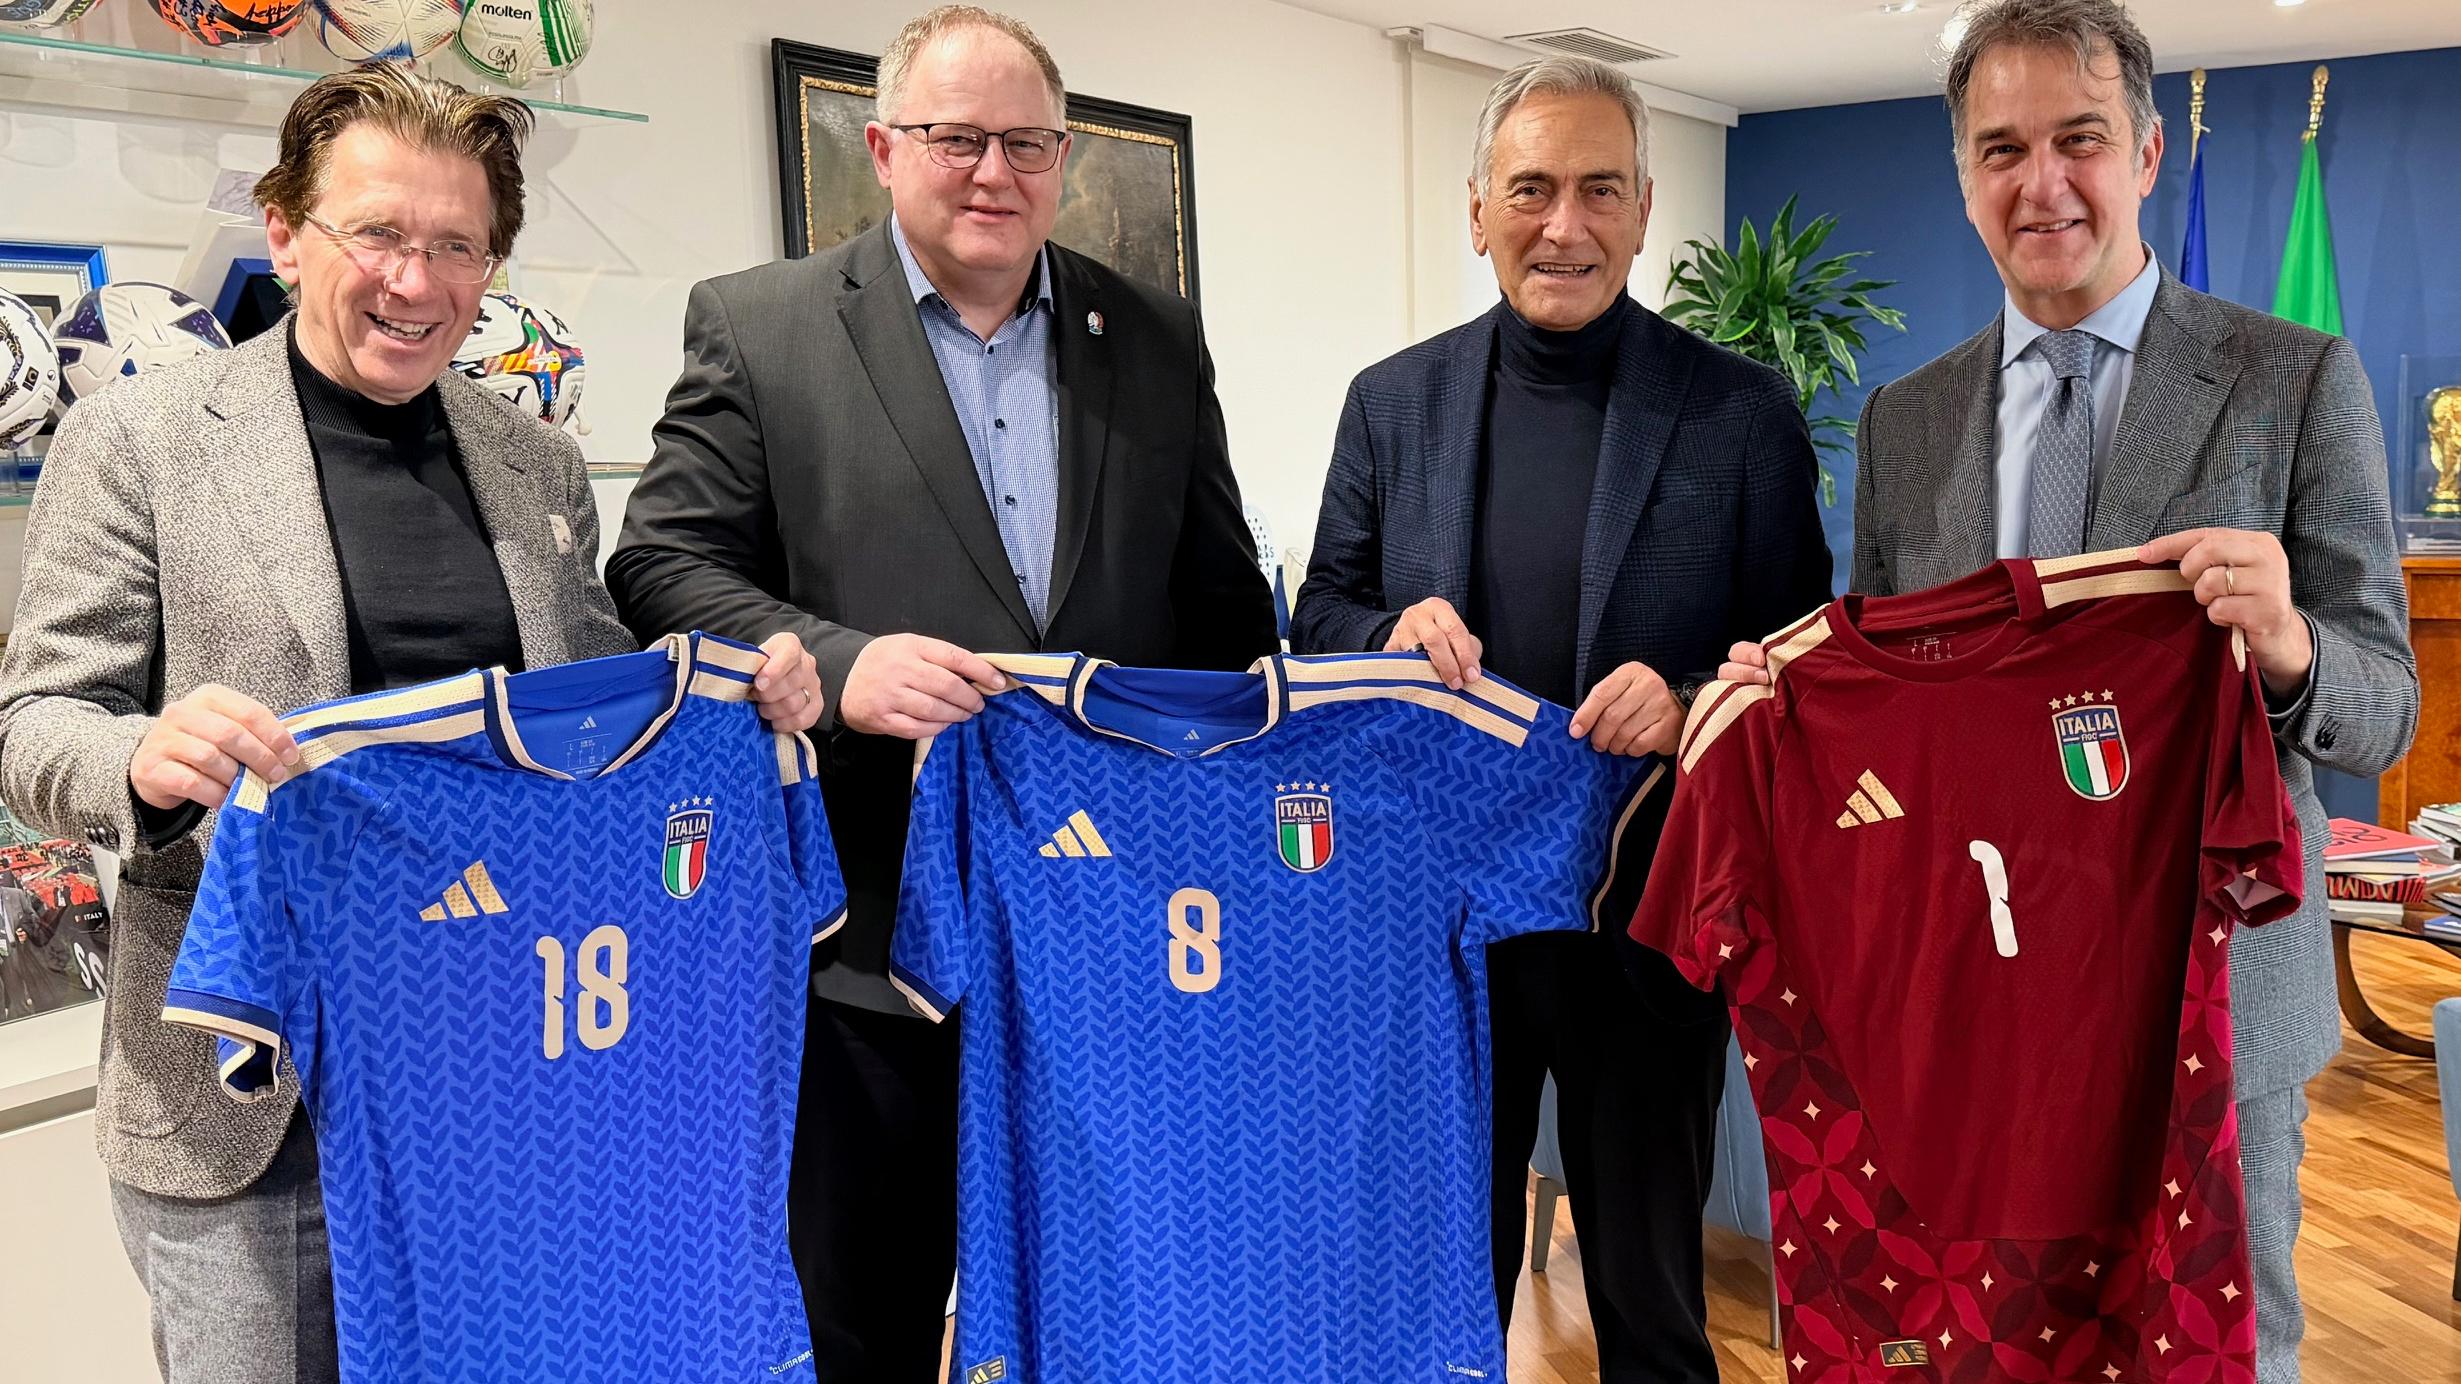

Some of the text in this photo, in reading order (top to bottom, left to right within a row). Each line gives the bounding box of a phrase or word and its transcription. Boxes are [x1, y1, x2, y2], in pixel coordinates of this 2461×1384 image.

[481, 4, 532, 21] molten
[2059, 712, 2115, 736] ITALIA
[1280, 801, 1327, 817] ITALIA
[670, 816, 708, 839] ITALIA
[1969, 840, 2018, 957] 1
[84, 911, 104, 922] ITALY
[1168, 888, 1221, 993] 8
[536, 925, 628, 1060] 18
